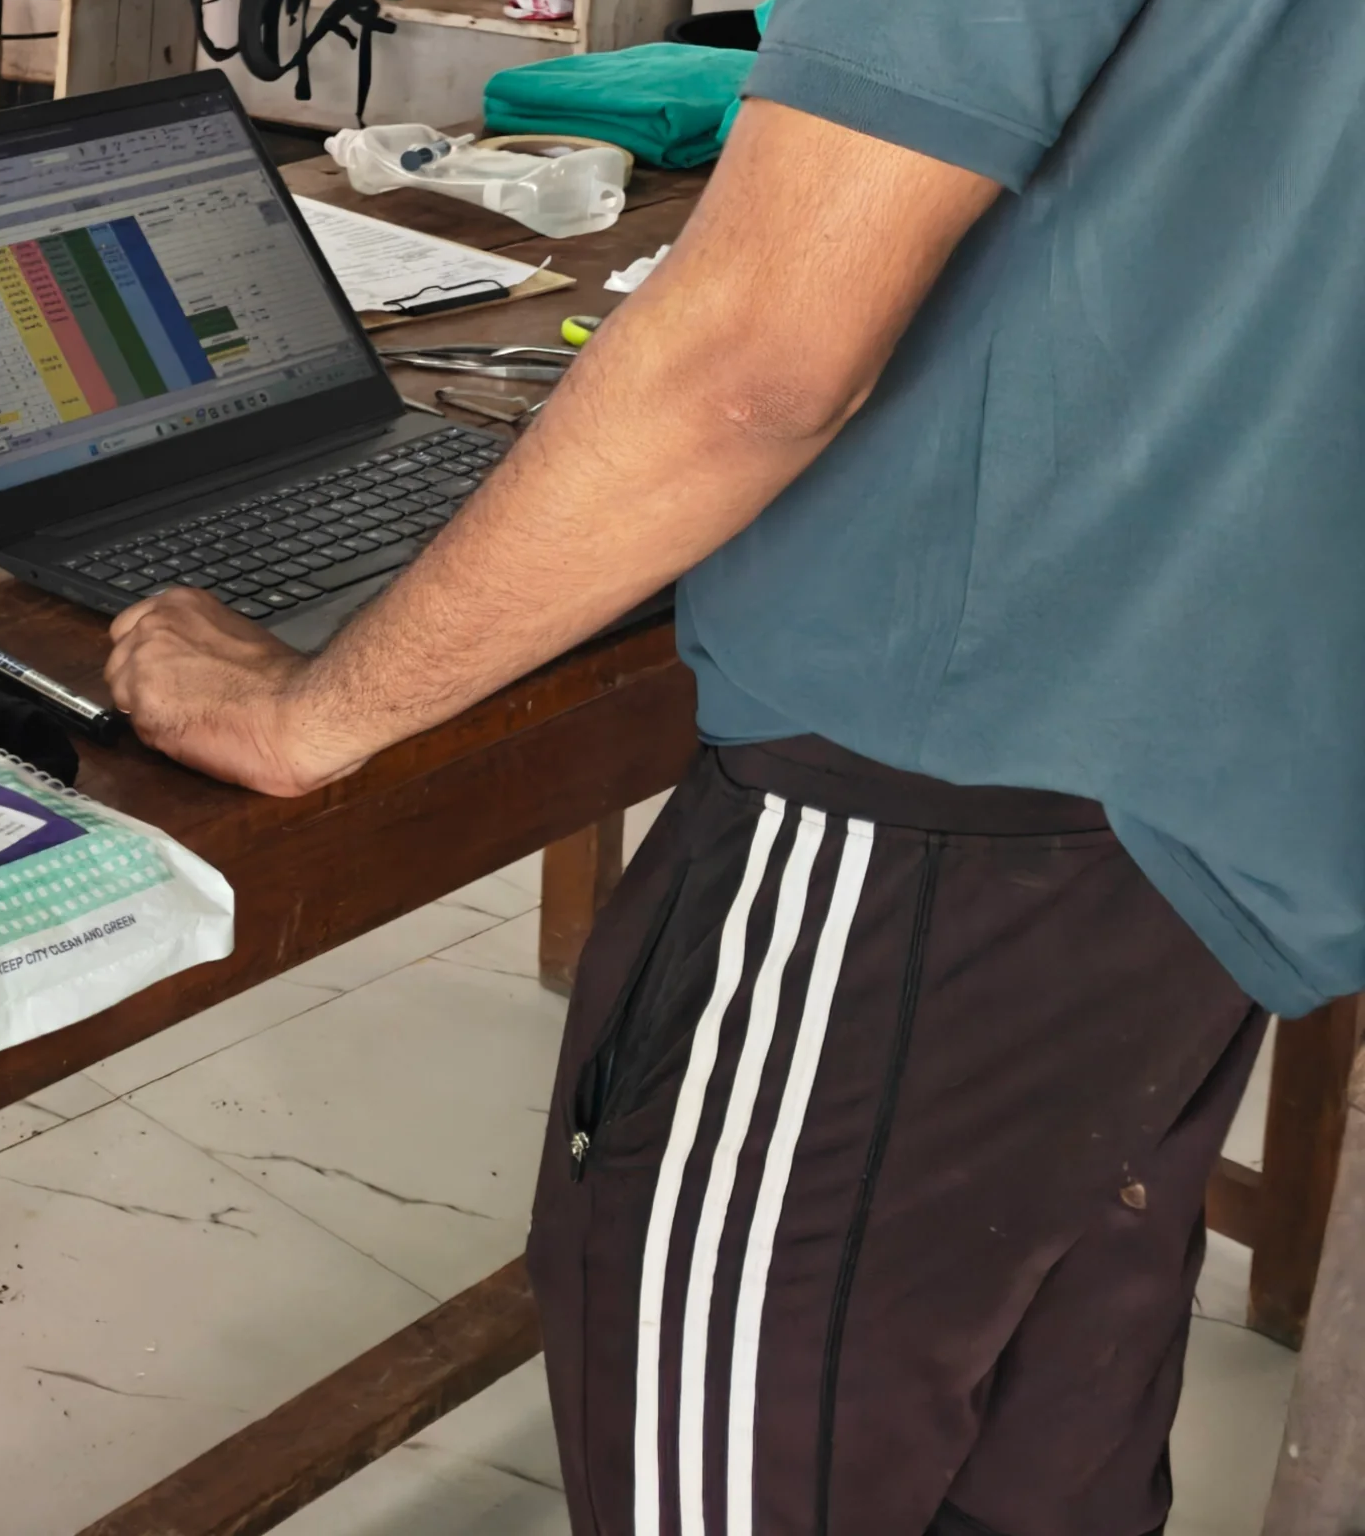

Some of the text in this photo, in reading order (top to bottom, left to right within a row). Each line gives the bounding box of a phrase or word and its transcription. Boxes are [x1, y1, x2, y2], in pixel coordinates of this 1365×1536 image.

[25, 947, 51, 966] CITY
[49, 936, 83, 956] CLEAN
[83, 926, 104, 944] AND
[103, 913, 137, 935] GREEN
